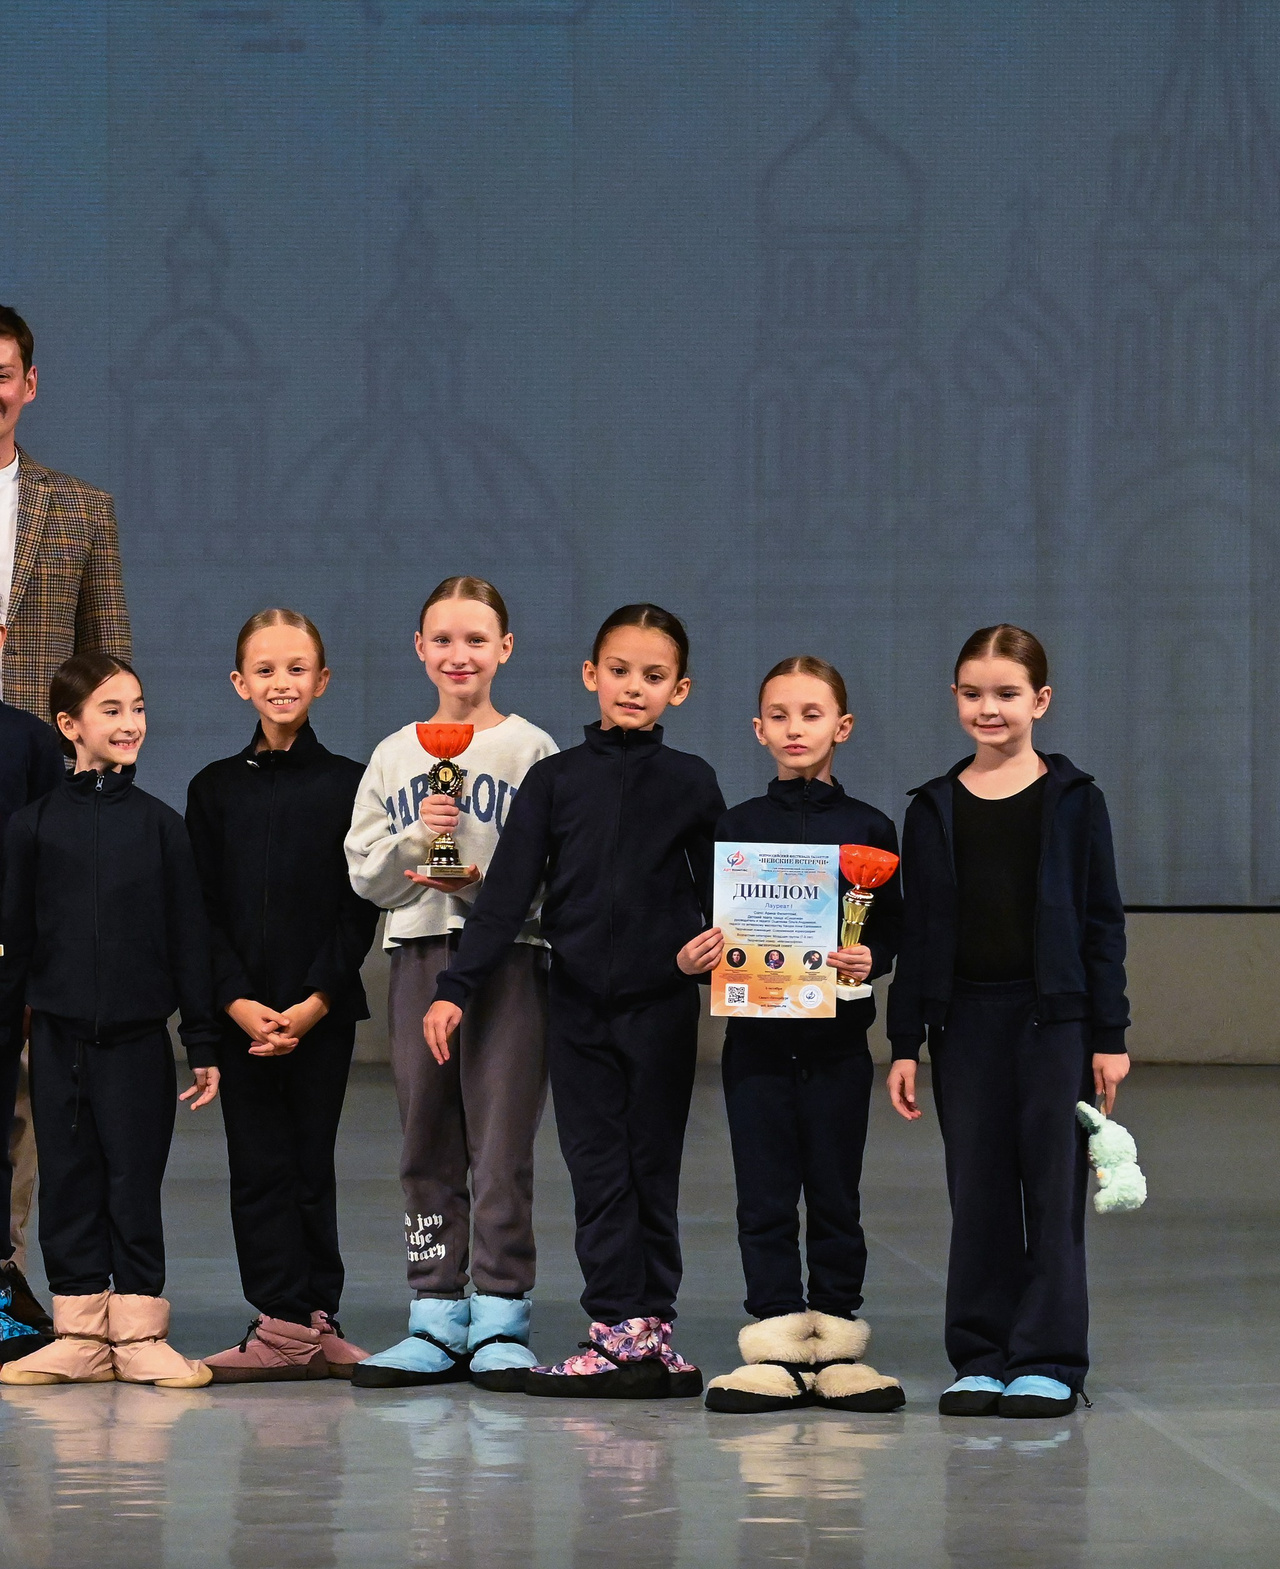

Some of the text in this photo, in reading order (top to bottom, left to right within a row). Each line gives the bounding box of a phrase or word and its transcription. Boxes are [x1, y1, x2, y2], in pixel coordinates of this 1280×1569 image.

[733, 883, 819, 901] ДИПЛОМ
[417, 1213, 443, 1231] joy
[410, 1231, 433, 1249] the
[407, 1243, 446, 1262] inary
